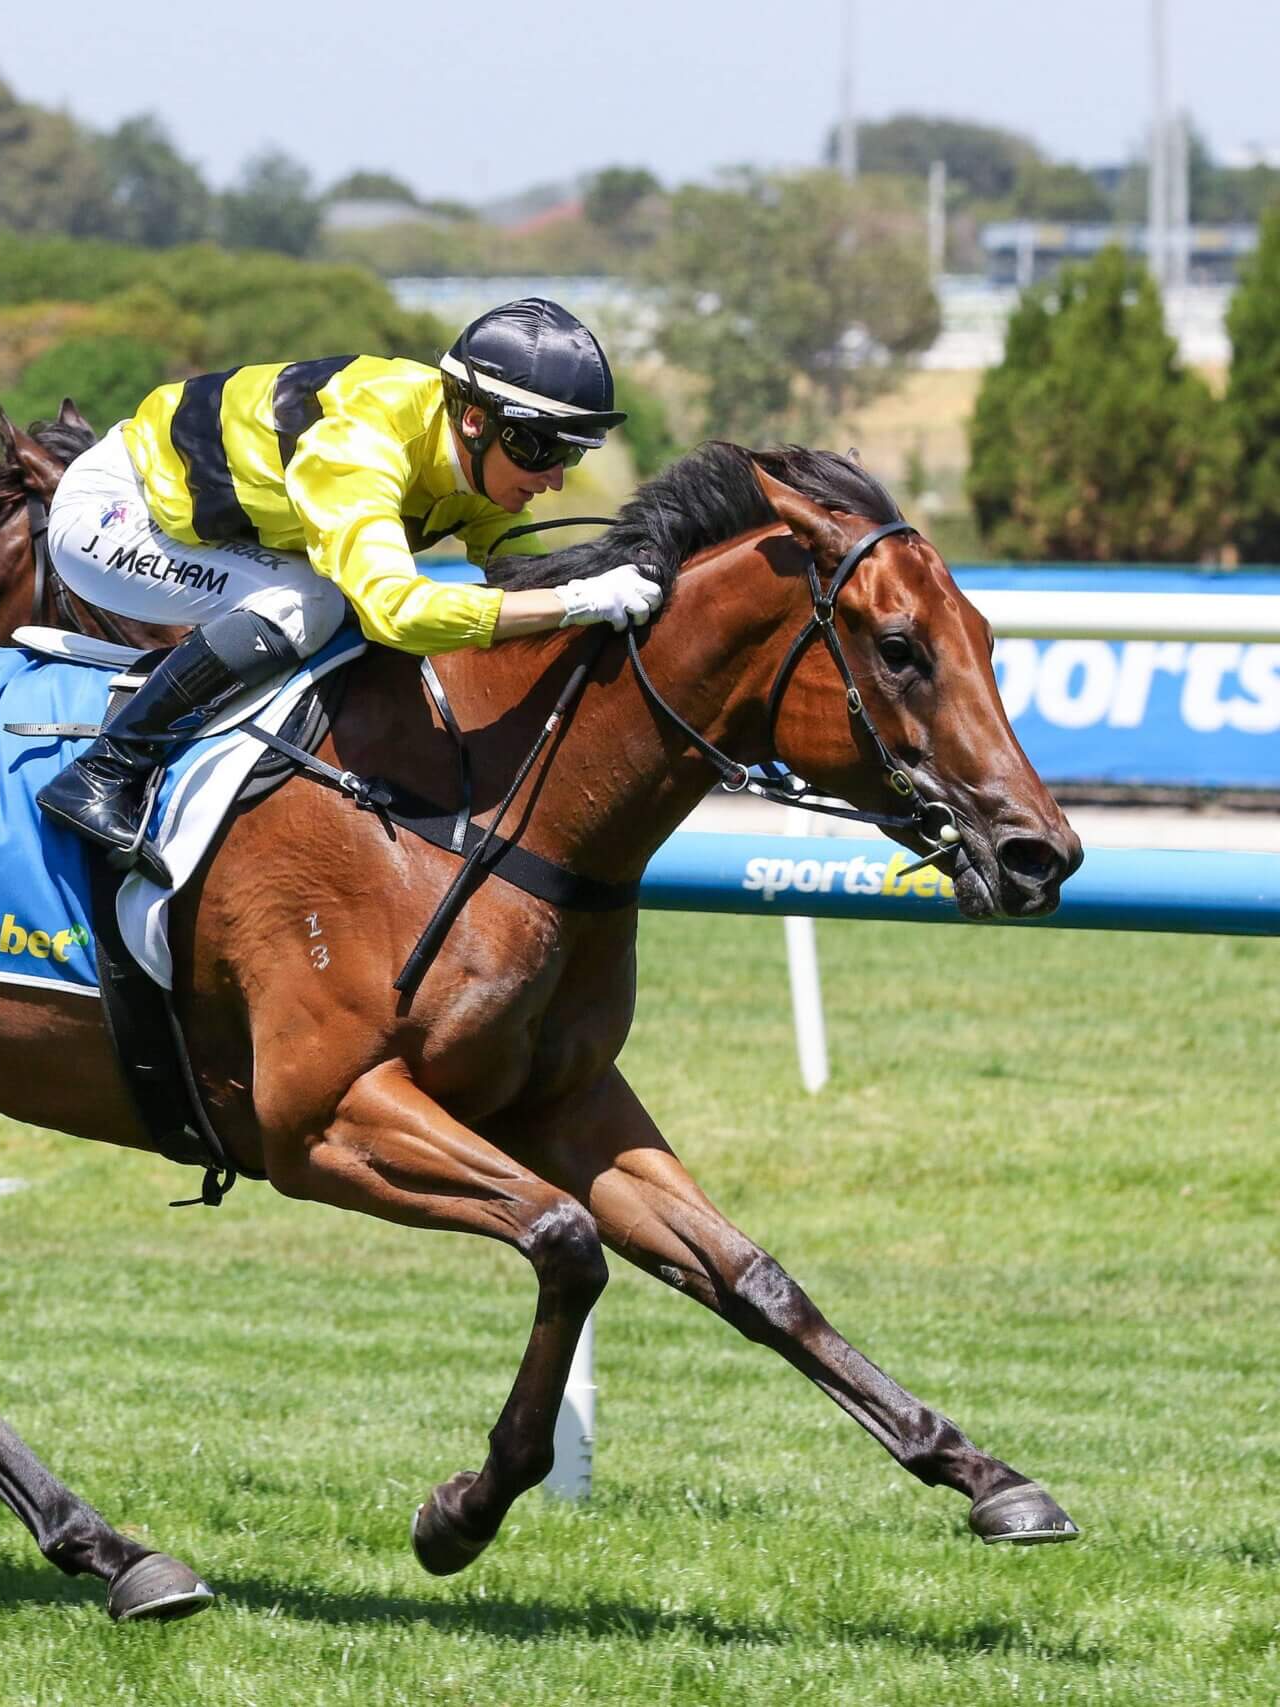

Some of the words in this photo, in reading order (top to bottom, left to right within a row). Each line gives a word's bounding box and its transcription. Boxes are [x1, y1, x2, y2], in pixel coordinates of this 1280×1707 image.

[81, 535, 99, 560] J.
[106, 546, 229, 595] MELHAM
[310, 944, 330, 970] 3
